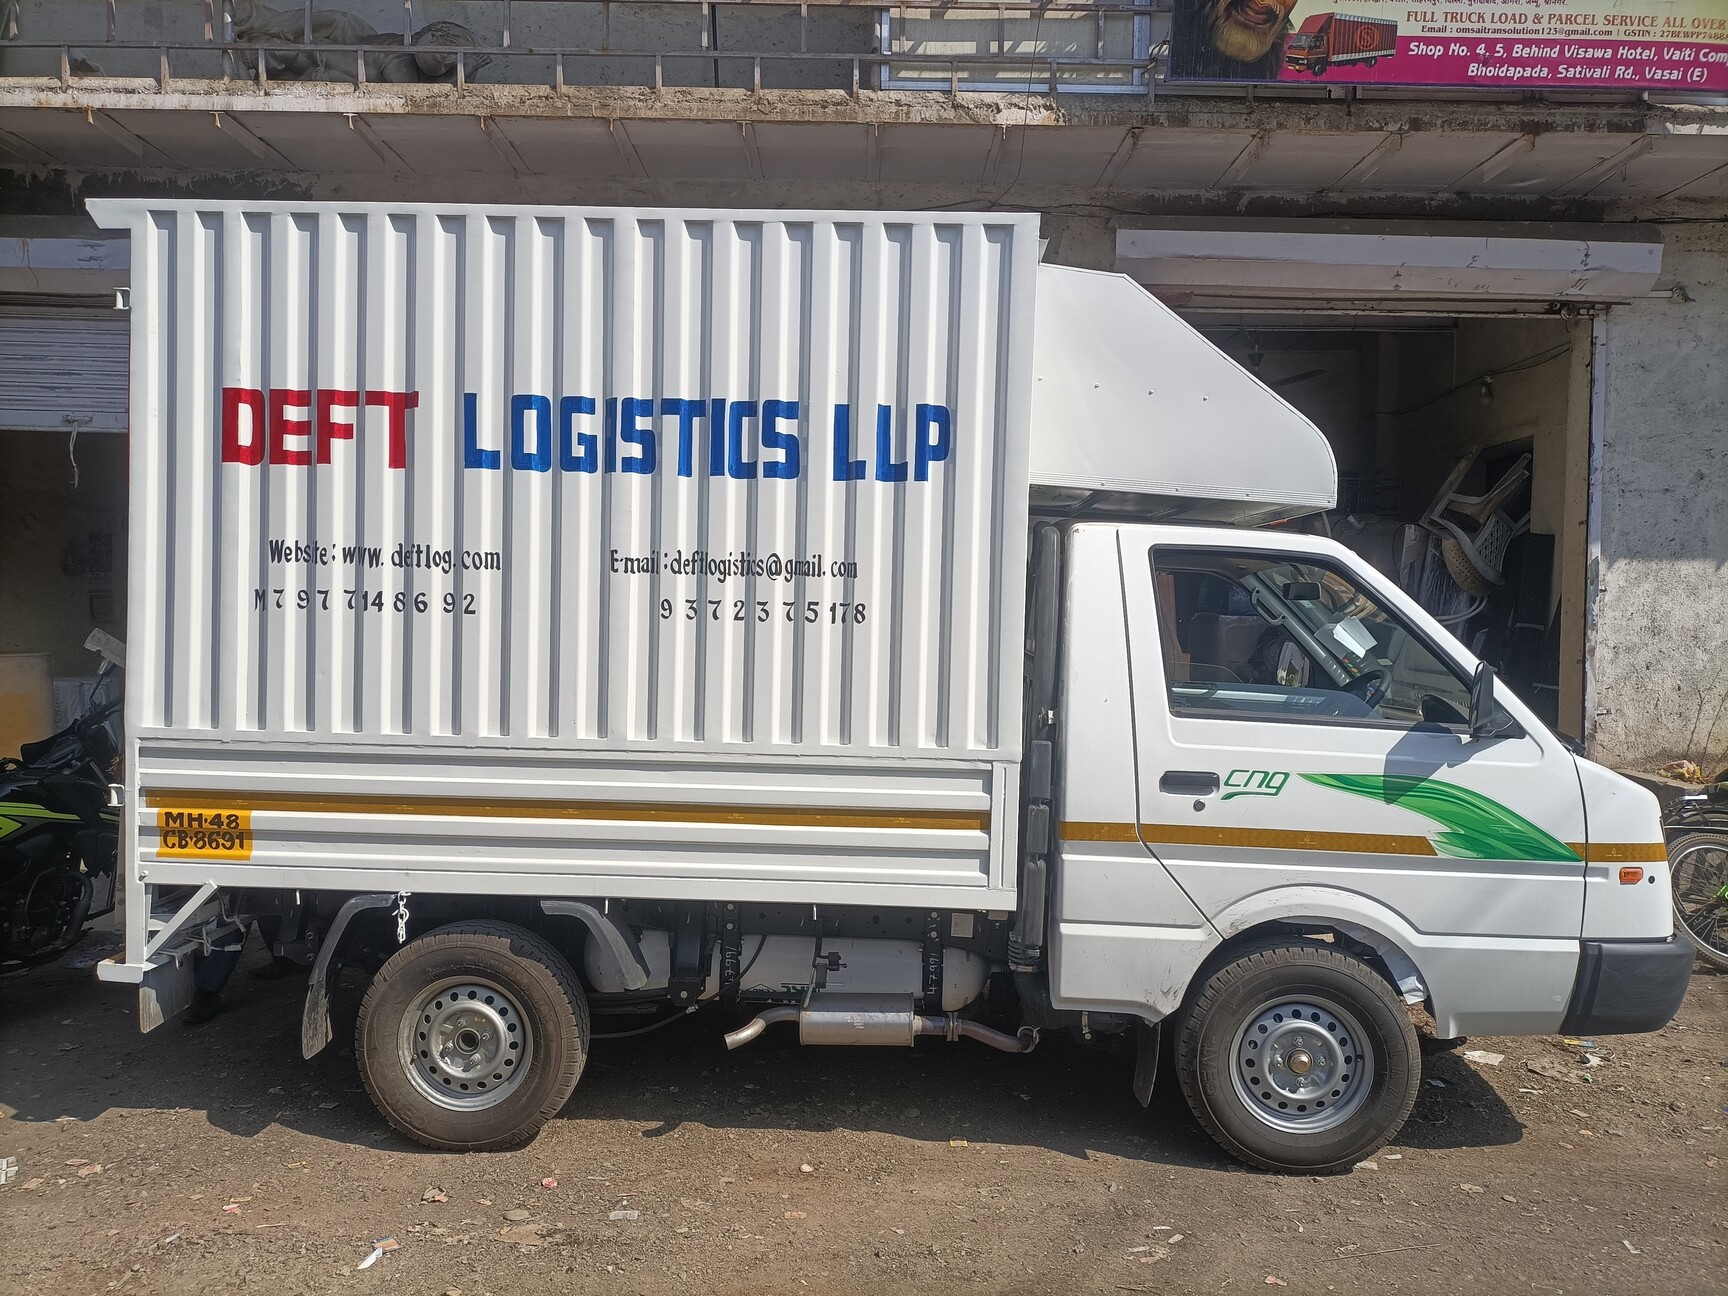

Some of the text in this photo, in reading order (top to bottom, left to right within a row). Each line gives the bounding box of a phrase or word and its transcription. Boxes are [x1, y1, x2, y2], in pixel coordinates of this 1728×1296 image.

[1406, 11, 1726, 30] FULL TRUCK LOAD & PARCEL SERVICE ALL OVER
[1421, 25, 1447, 33] Email
[1623, 29, 1651, 37] GSTIN
[1408, 42, 1444, 59] Shop
[1449, 43, 1471, 56] No.
[1494, 43, 1507, 58] 5,
[1512, 44, 1560, 58] Behind
[1564, 45, 1612, 59] Visawa
[1617, 46, 1659, 61] Hotel,
[1663, 47, 1696, 61] Vaiti
[1468, 63, 1708, 83] Bhoidapada, Sativali Rd., Vasai (E)
[222, 387, 951, 482] DEFT LOGISTICS LLP
[1221, 769, 1291, 801] cng
